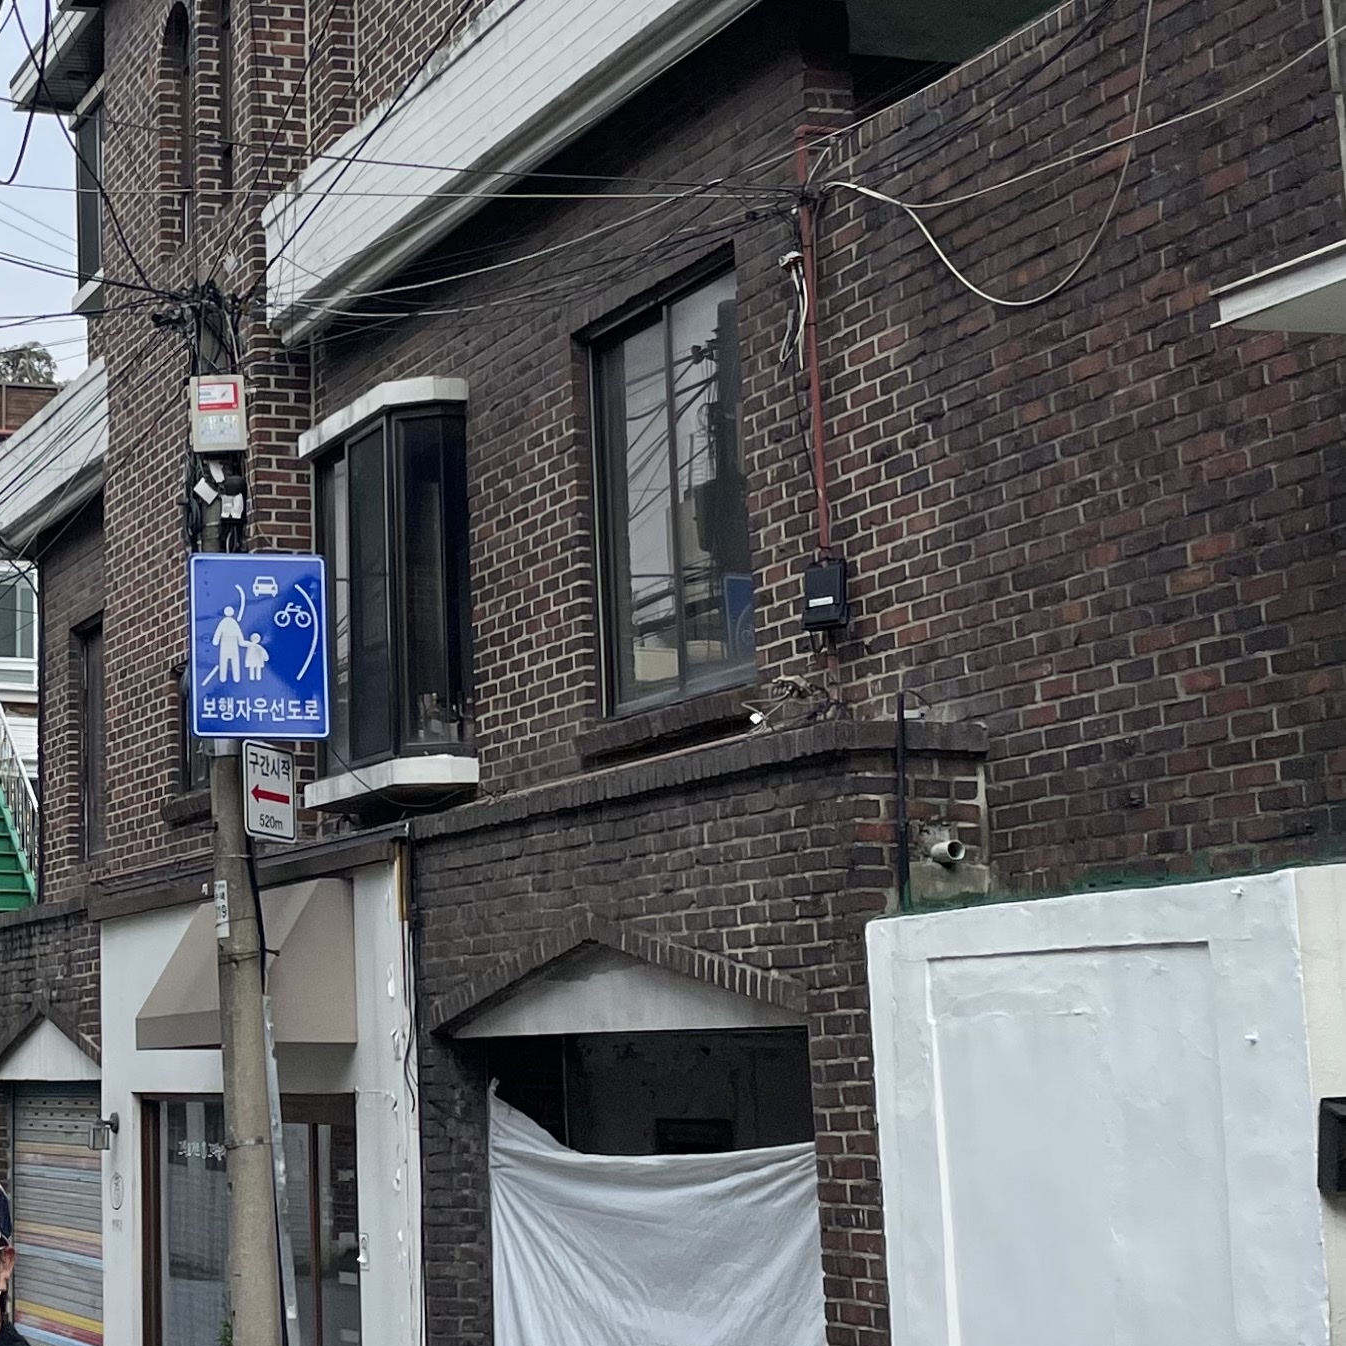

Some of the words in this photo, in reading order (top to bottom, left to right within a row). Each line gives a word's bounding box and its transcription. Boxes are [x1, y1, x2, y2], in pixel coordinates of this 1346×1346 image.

[201, 696, 321, 722] 보행자우선도로
[249, 752, 291, 782] 구간시작
[259, 813, 284, 830] 520m
